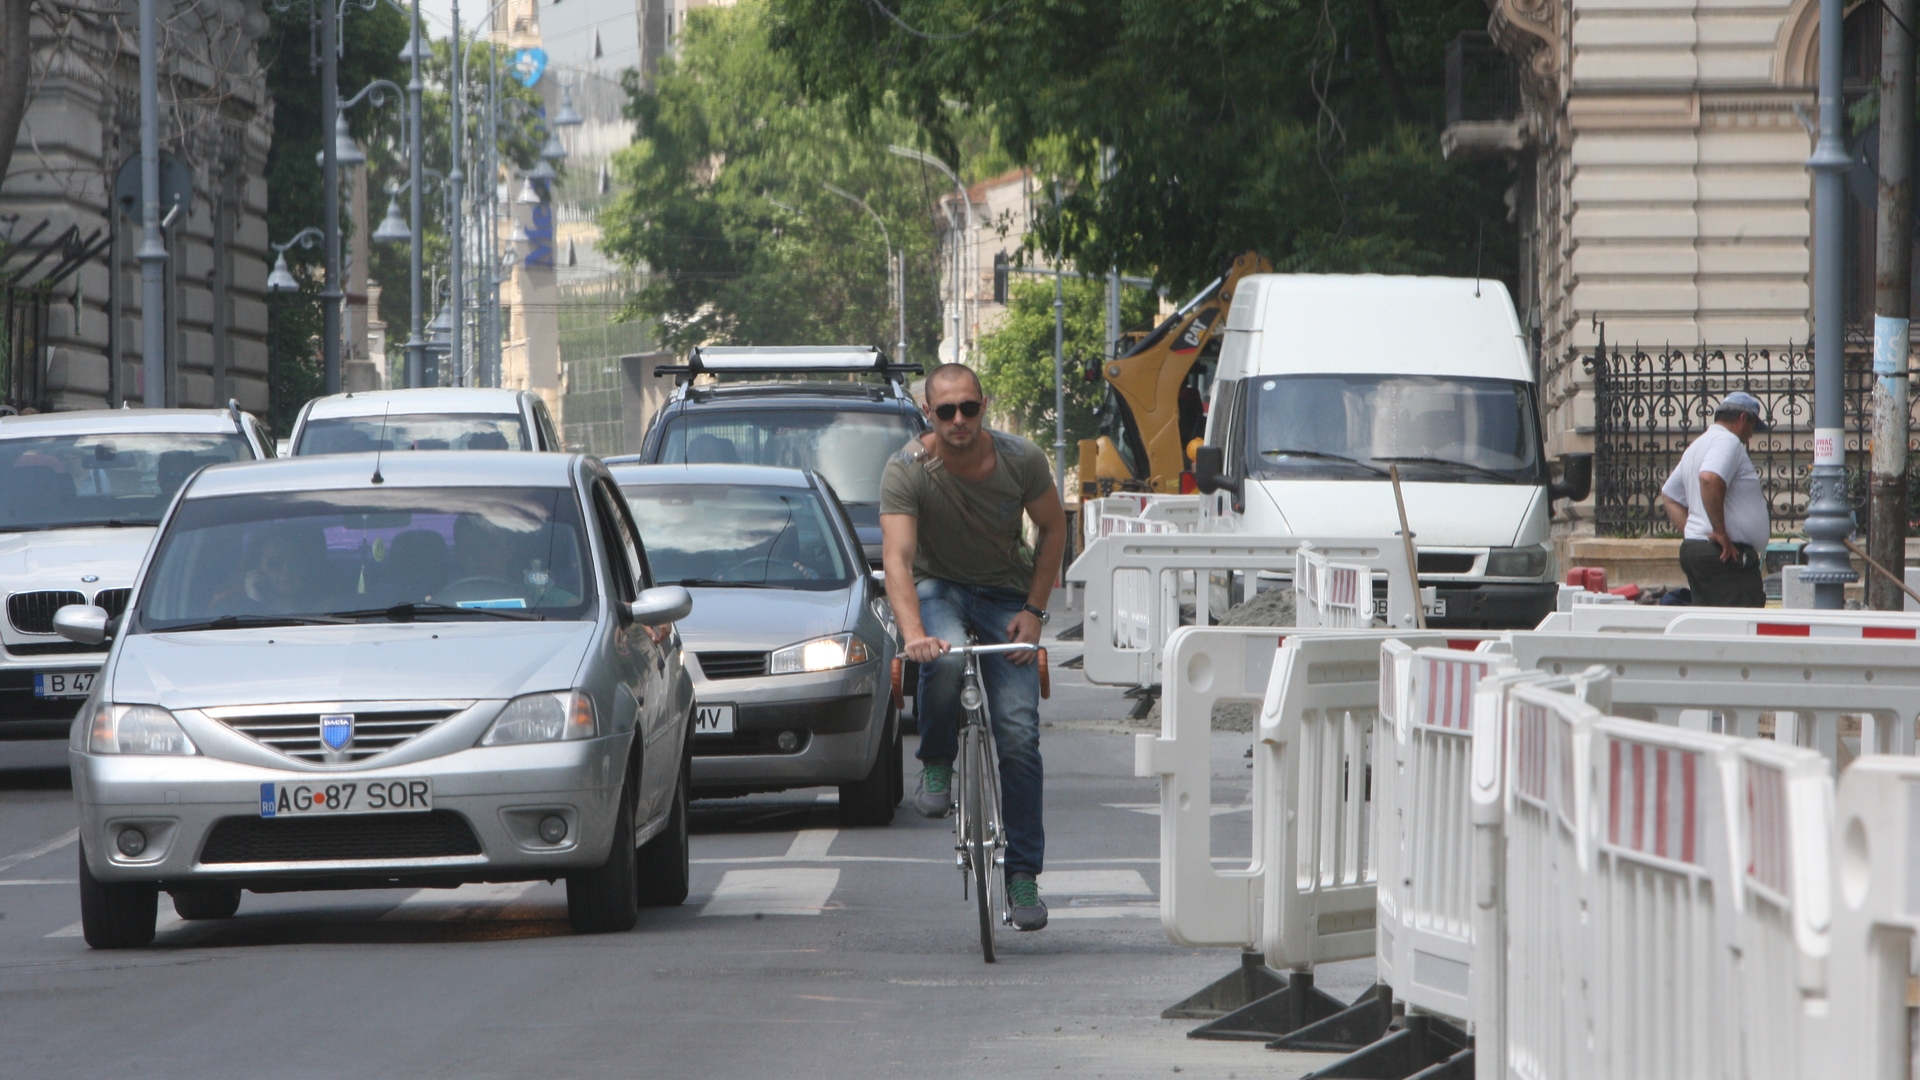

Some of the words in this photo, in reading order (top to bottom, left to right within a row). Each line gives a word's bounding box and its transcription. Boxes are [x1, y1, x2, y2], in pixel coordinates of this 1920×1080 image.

[1184, 318, 1208, 346] CAT
[35, 686, 44, 694] RO
[51, 675, 65, 692] B
[73, 673, 95, 691] 47
[696, 708, 722, 730] MV
[262, 800, 275, 813] RO
[277, 785, 313, 813] AG
[325, 783, 358, 810] 87
[366, 780, 429, 809] SOR
